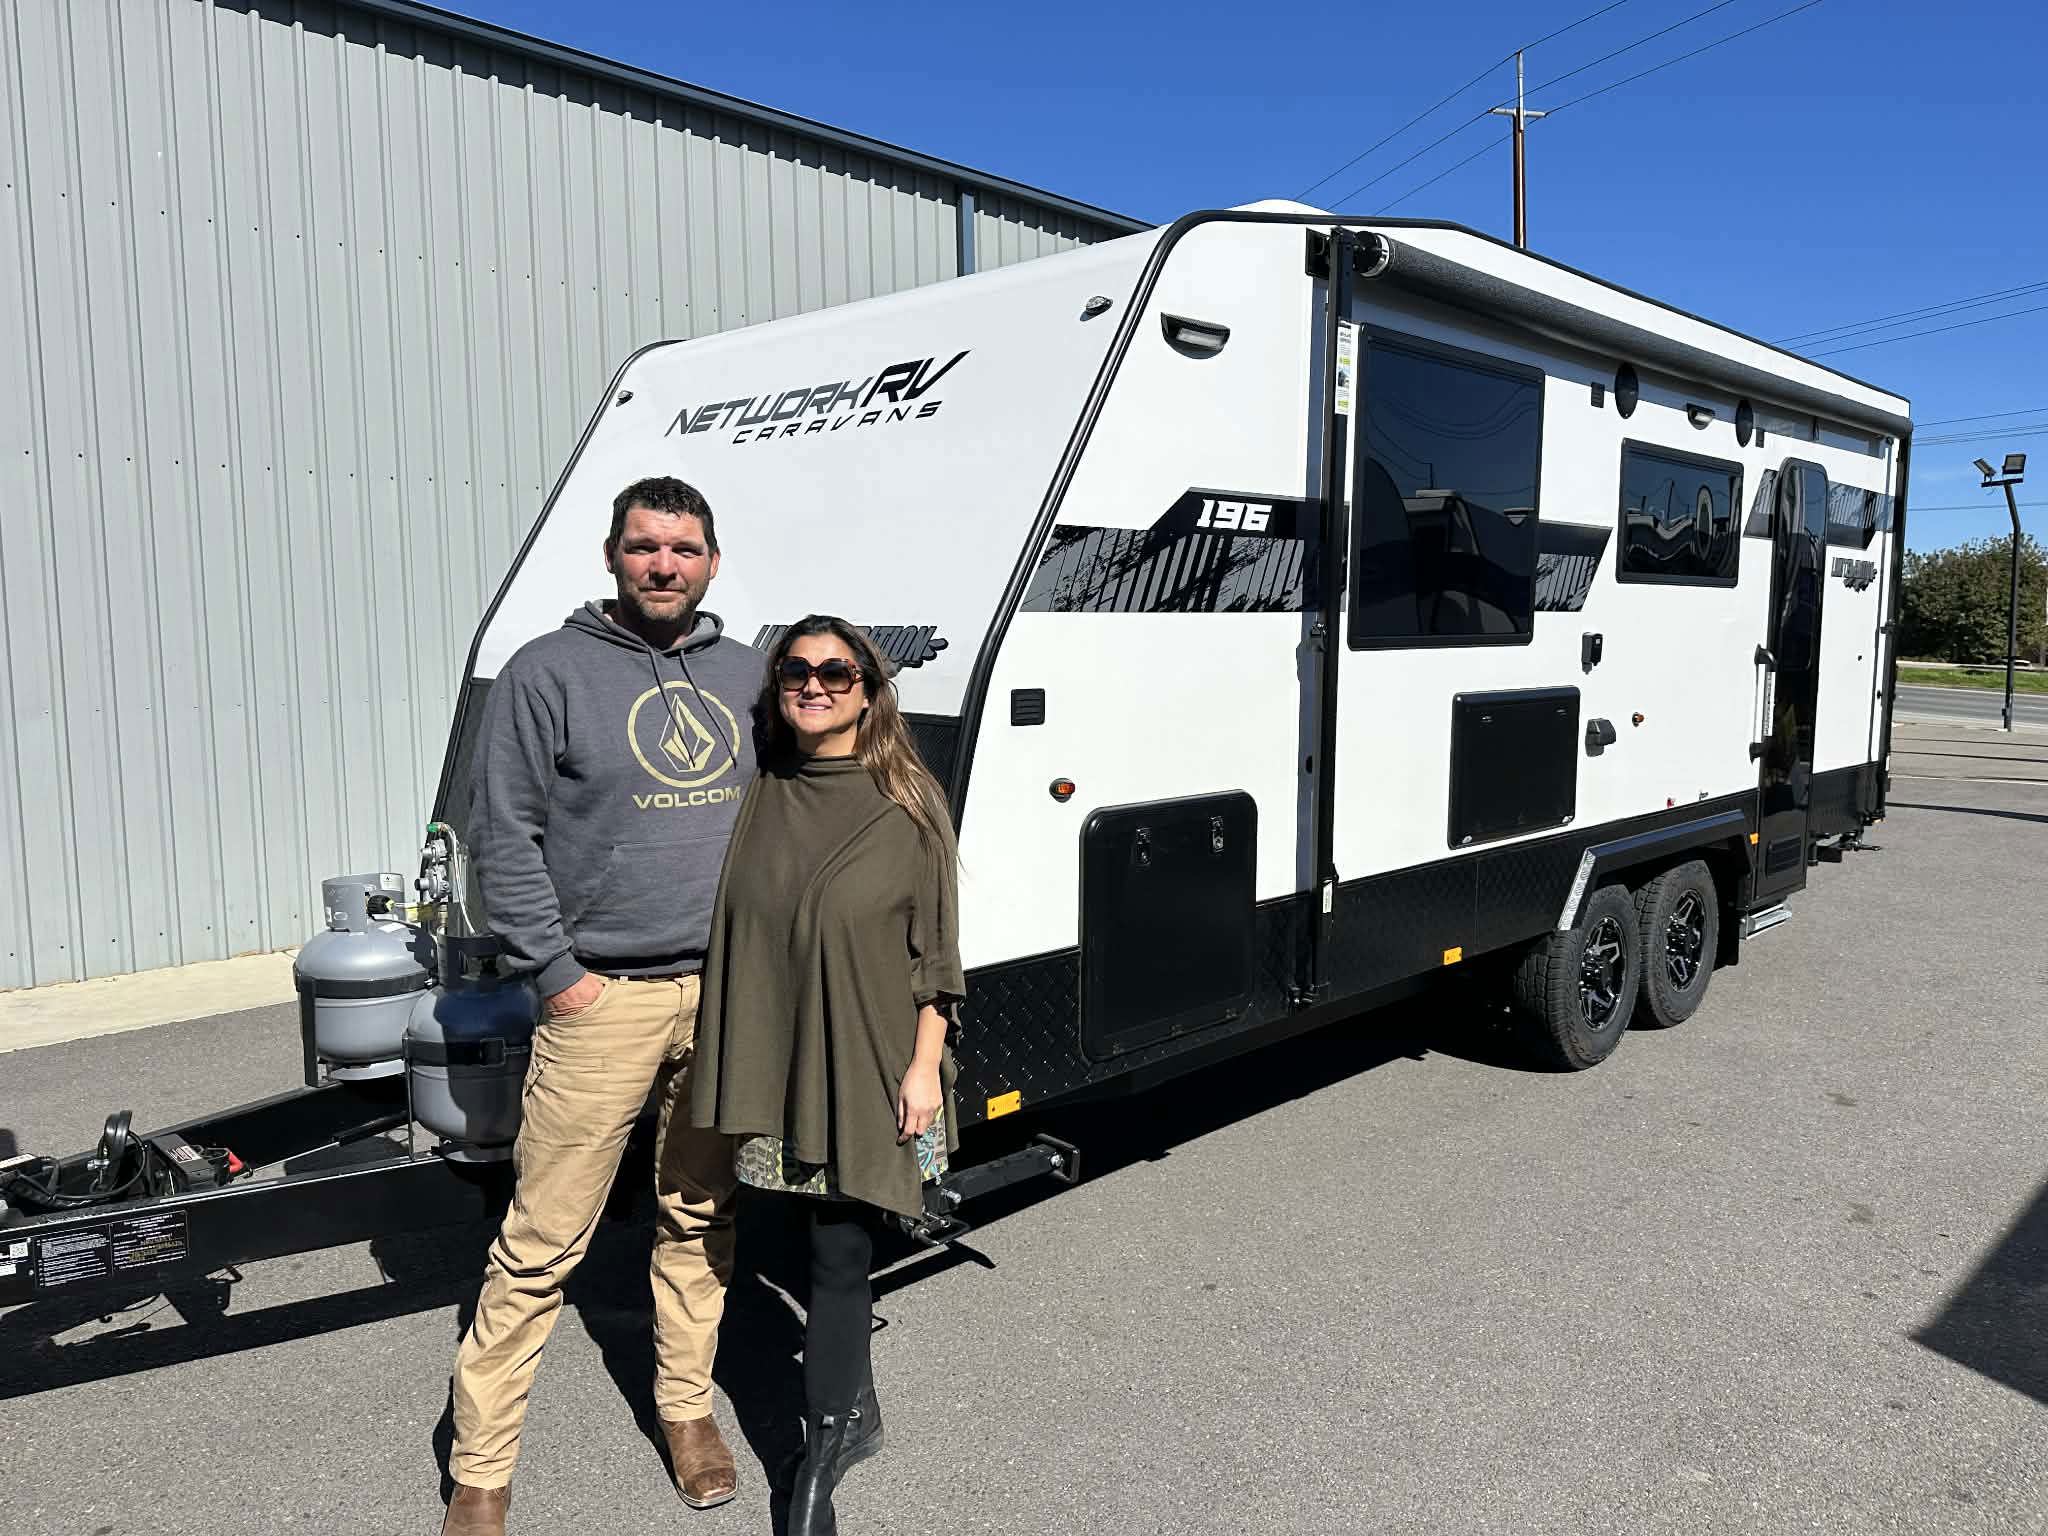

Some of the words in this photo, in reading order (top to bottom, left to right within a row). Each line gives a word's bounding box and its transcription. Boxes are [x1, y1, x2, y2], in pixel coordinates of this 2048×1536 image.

[732, 401, 942, 444] CARAVANS
[1196, 499, 1273, 532] 196
[632, 786, 741, 809] VOLCOM
